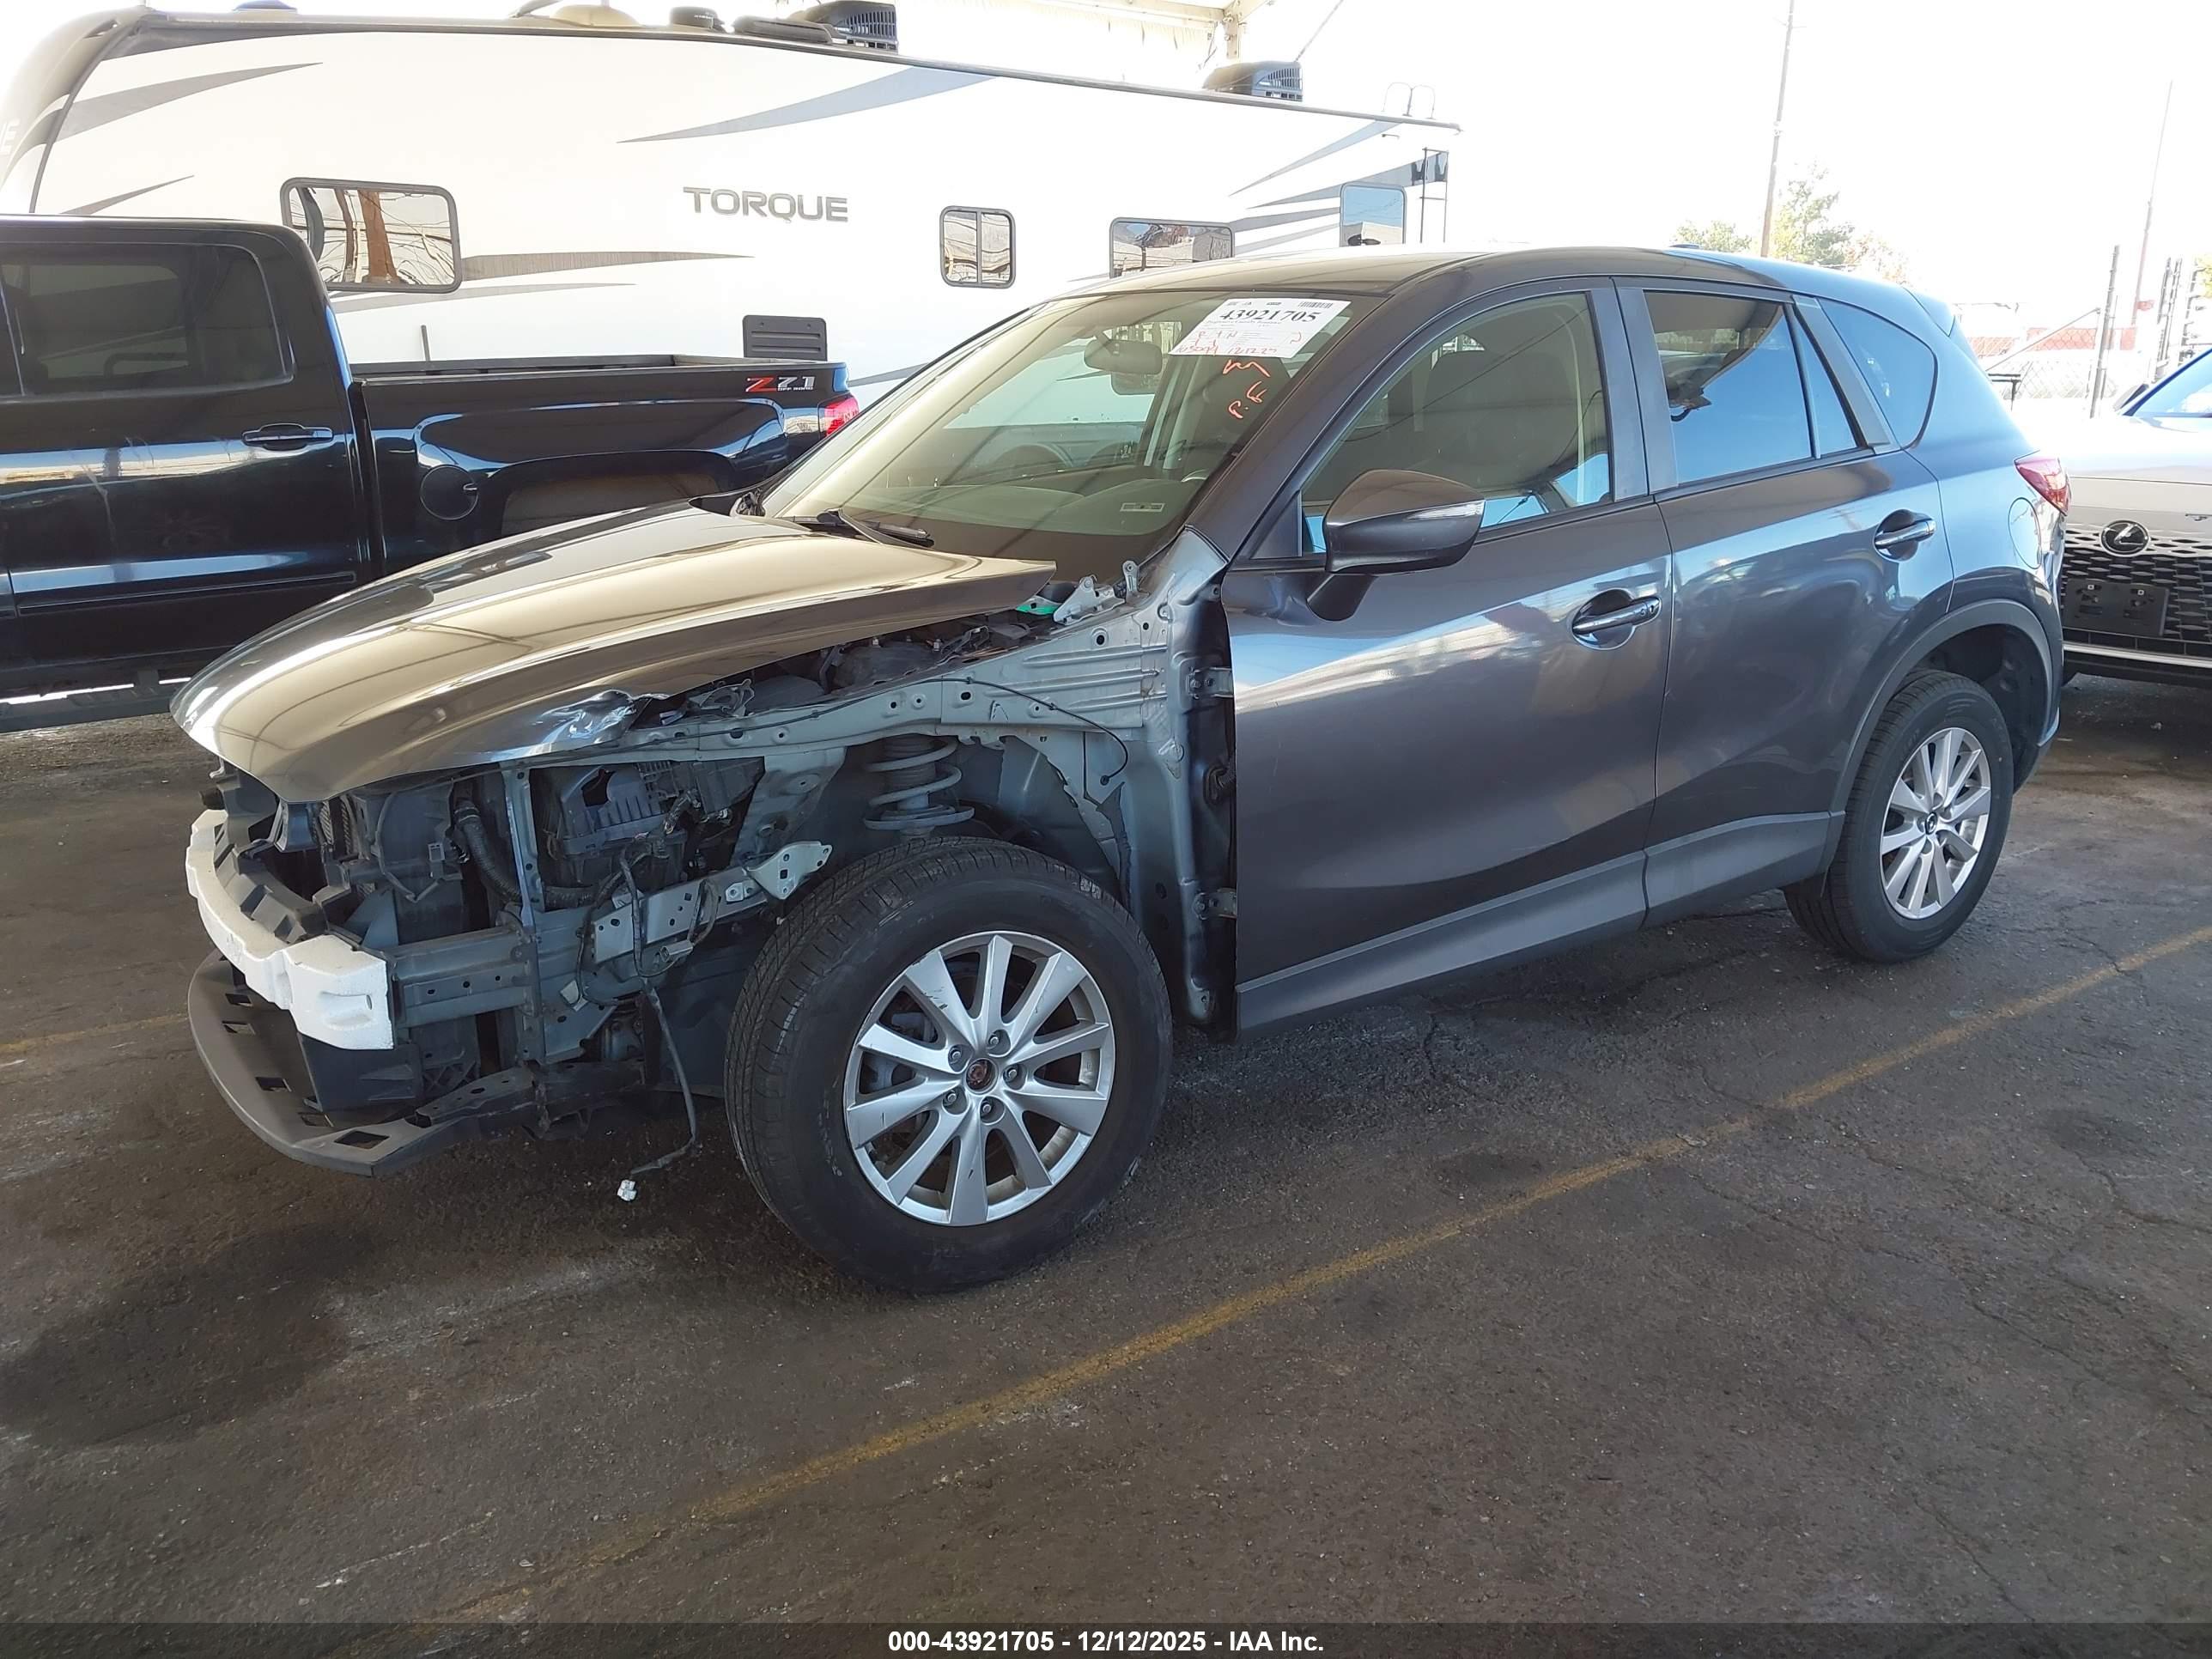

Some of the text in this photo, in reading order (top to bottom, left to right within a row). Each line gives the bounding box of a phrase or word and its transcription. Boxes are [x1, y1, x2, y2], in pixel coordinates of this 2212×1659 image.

[683, 186, 848, 223] TORQUE
[1219, 309, 1322, 322] 43921705
[745, 376, 816, 392] Z71
